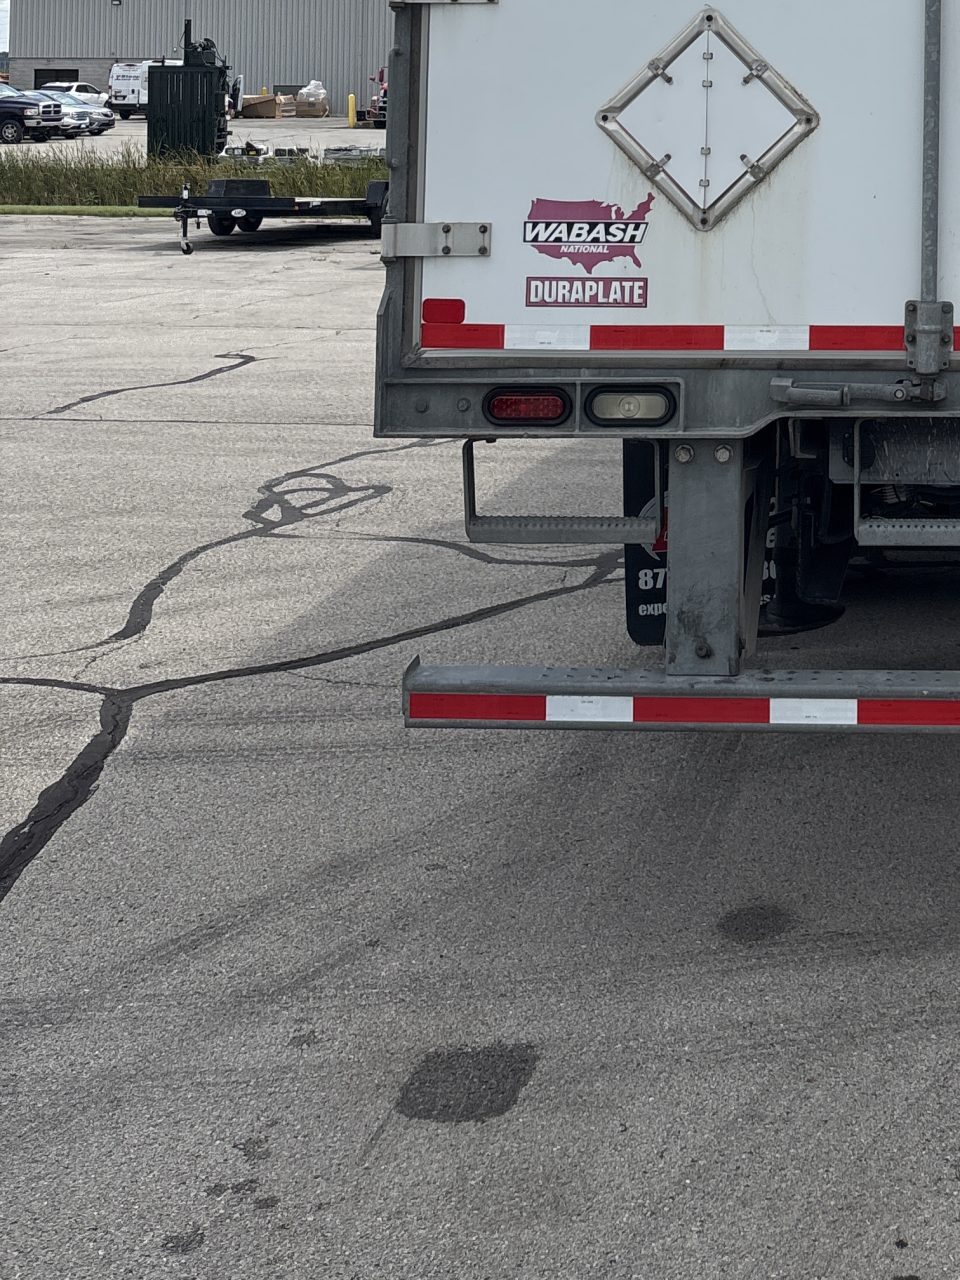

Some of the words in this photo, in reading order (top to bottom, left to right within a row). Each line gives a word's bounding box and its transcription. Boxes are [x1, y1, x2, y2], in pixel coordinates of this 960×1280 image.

[525, 222, 647, 242] WABASH
[560, 245, 609, 254] NATIONAL
[530, 280, 645, 304] DURAPLATE
